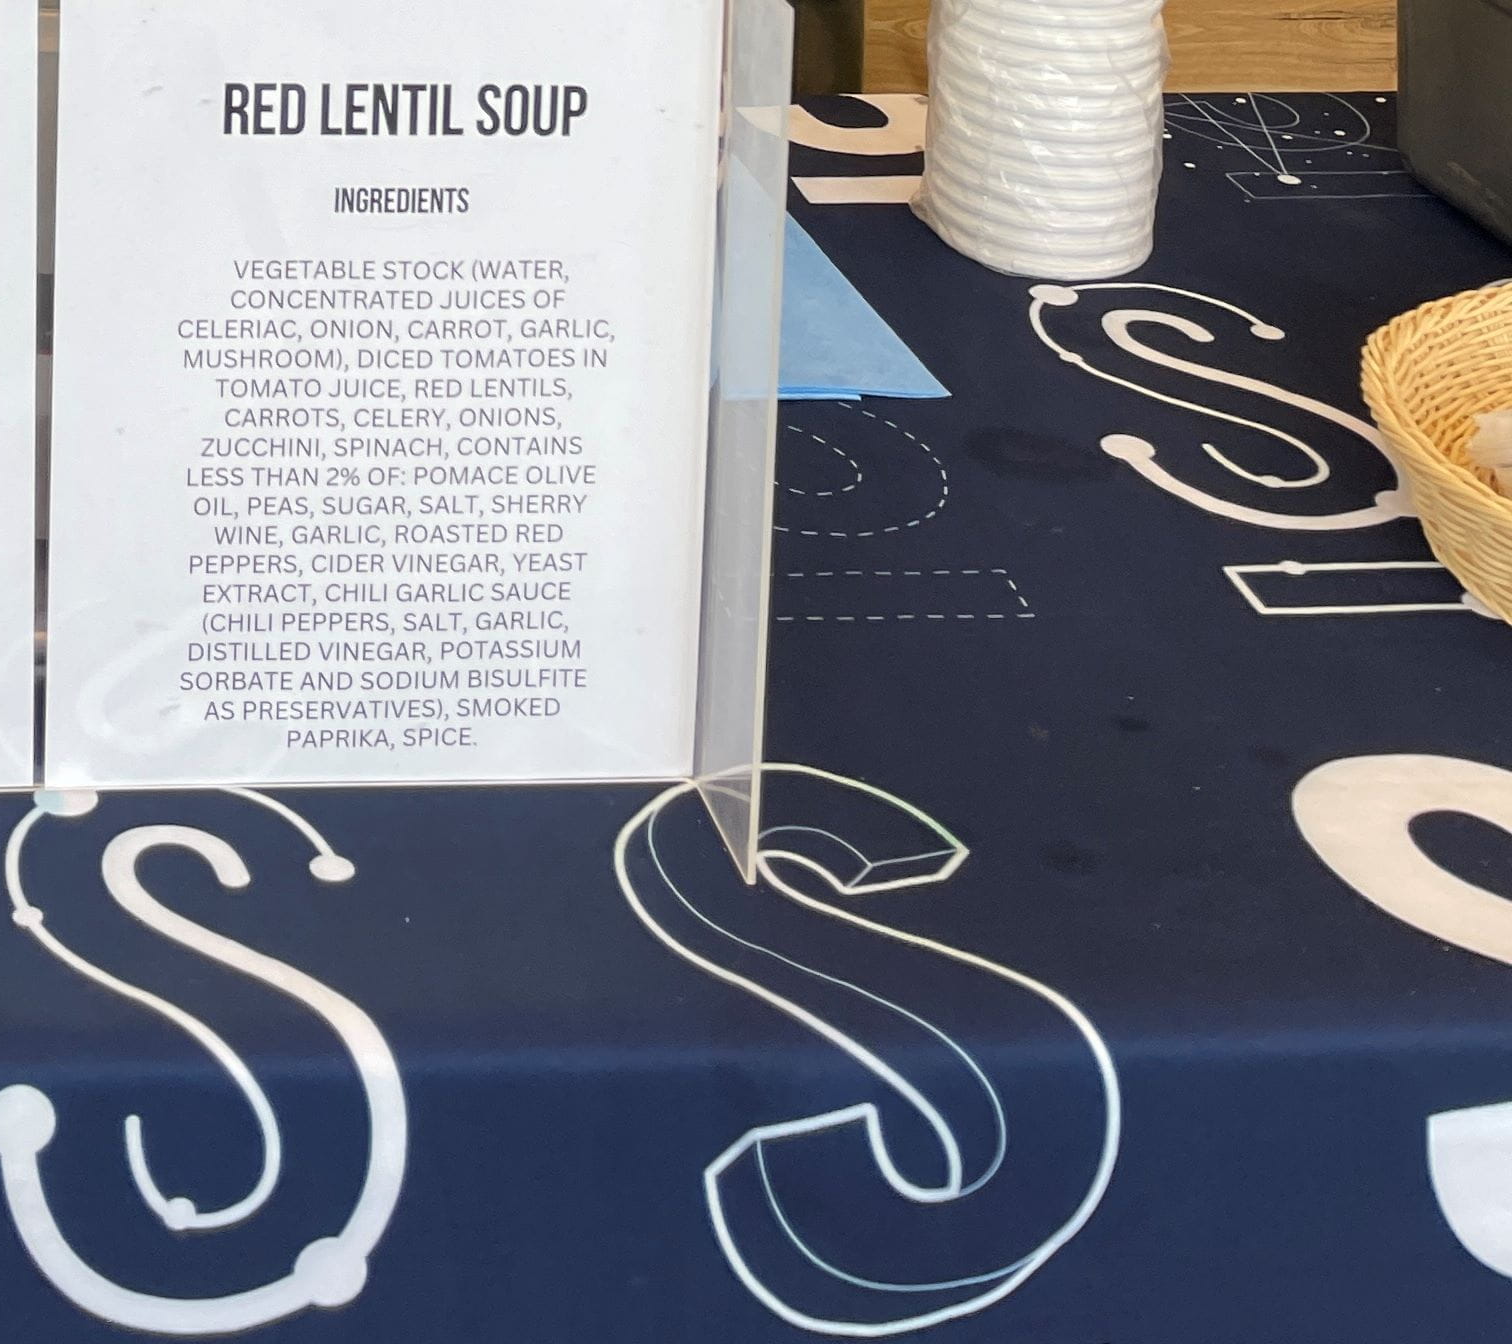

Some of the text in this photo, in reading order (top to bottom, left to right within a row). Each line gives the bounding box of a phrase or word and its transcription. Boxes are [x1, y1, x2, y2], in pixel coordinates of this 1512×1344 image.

[224, 83, 587, 136] RED LENTIL SOUP
[335, 188, 469, 213] INGREDIENTS
[232, 258, 570, 284] VEGETABLE STOCK (WATER,
[230, 288, 566, 310] CONCENTRATED JUICES OF
[177, 318, 616, 344] CELERIAC, ONION, CARROT, GARLIC,
[183, 347, 608, 373] MUSHROOM), DICED TOMATOES IN
[200, 435, 583, 462] ZUCCHINI, SPINACH, CONTAINS
[186, 464, 597, 487] LESS THAN 2% OF: POMACE OLIVE
[193, 493, 588, 521] OIL, PEAS, SUGAR, SALT, SHERRY
[189, 551, 589, 578] PEPPERS, CIDER VINEGAR, YEAST
[202, 581, 572, 607] EXTRACT, CHILI GARLIC SAUCE
[187, 639, 581, 665] DISTILLED VINEGAR, POTASSIUM
[179, 668, 588, 692] SORBATE AND SODIUM BISULFITE
[203, 697, 561, 722] AS PRESERVATIVES), SMOKED
[286, 726, 478, 752] PAPRIKA, SPICE.
